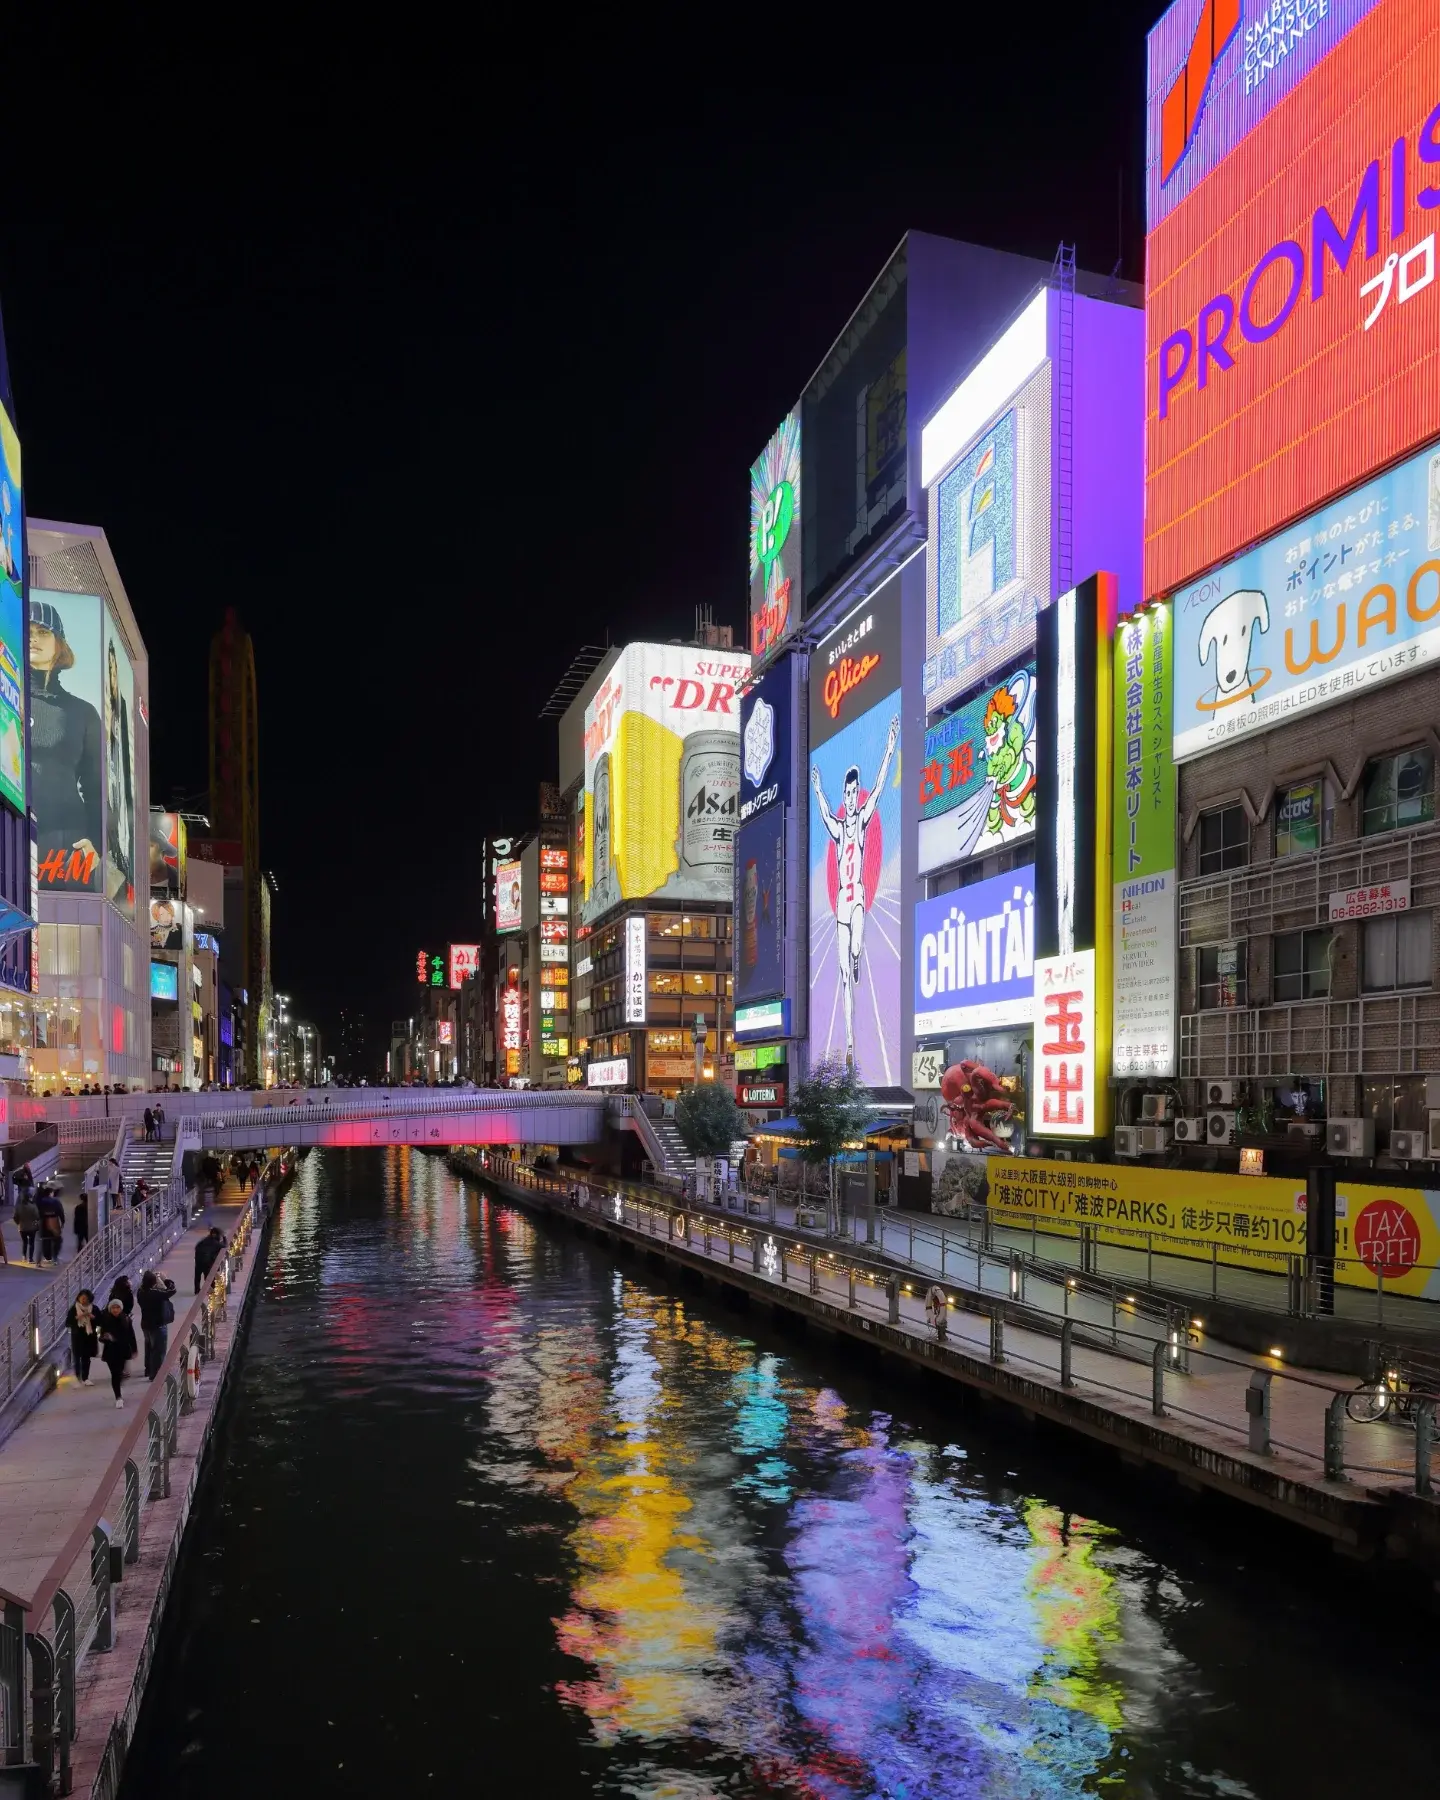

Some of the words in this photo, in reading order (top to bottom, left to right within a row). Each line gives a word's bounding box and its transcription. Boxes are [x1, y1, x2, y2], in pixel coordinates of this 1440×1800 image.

[1360, 232, 1434, 332] プロ
[752, 577, 791, 656] ピップ
[824, 654, 879, 719] Glico
[1152, 616, 1164, 810] 不動産再生のスペシャリスト
[1125, 627, 1144, 872] 株式会社日本リート
[918, 739, 975, 807] 改源
[713, 828, 733, 841] 生
[37, 848, 94, 886] H&M
[845, 842, 855, 902] グリコ
[1122, 878, 1165, 899] NIHON
[1345, 885, 1392, 905] 広告募集
[1122, 913, 1147, 926] Estate
[1331, 897, 1407, 920] 06-6262-1313
[920, 885, 1034, 999] CHINTAI
[1122, 950, 1149, 961] SERVICE
[1042, 990, 1086, 1124] 玉出
[1117, 1044, 1169, 1058] 広告主募集中
[1117, 1060, 1169, 1073] 06-6281-1717
[749, 1089, 776, 1101] LOTTERIA
[1240, 1151, 1263, 1163] BAR
[1363, 1208, 1407, 1239] TAX
[1360, 1238, 1417, 1267] FREE!
